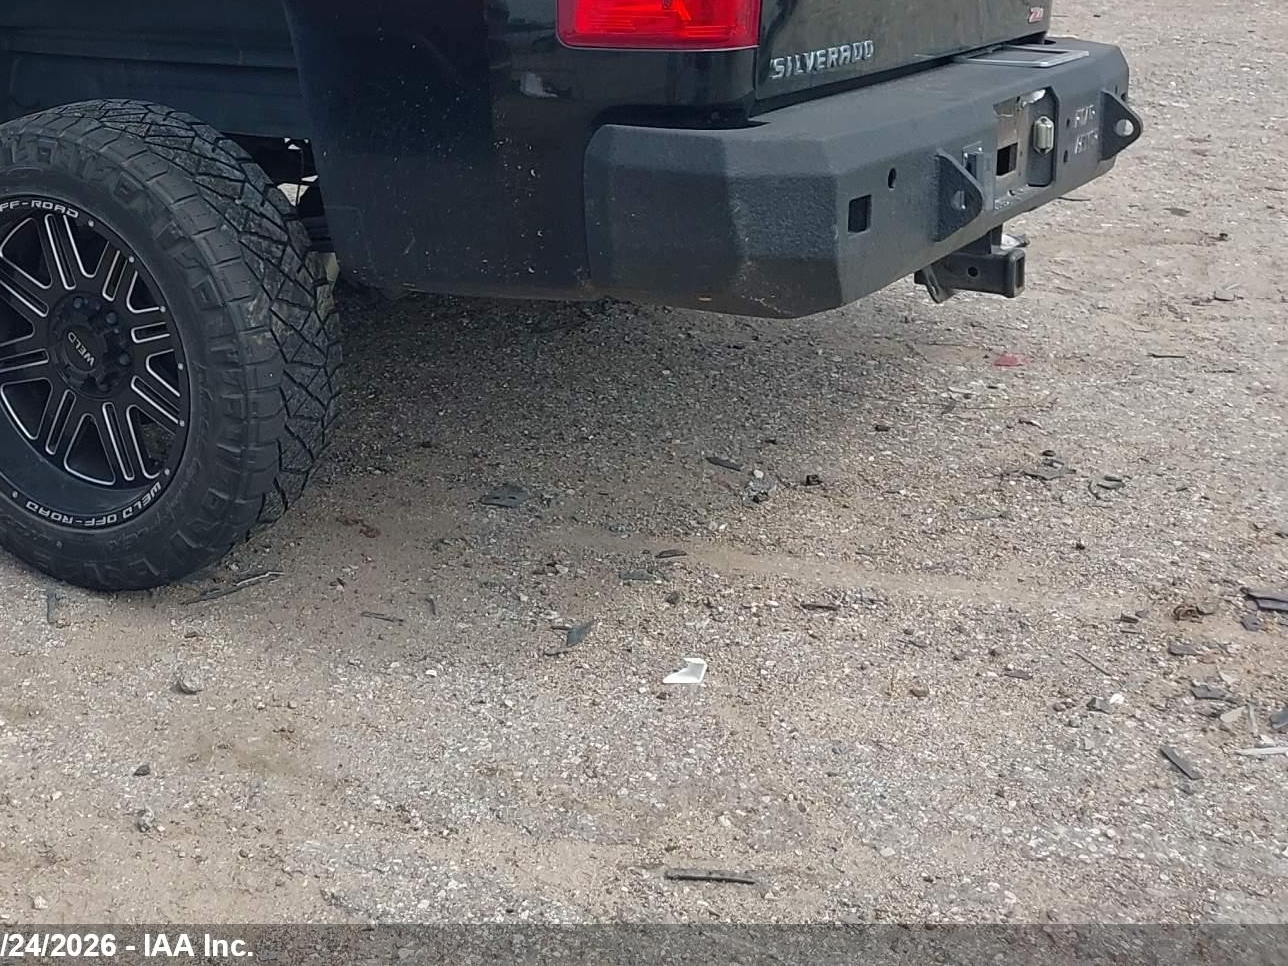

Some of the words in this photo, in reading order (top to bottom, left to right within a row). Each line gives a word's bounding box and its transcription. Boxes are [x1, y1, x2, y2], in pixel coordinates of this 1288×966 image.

[769, 40, 874, 79] SILVERADO
[68, 331, 95, 367] WELD
[25, 501, 117, 526] OFF-ROAD
[122, 481, 161, 519] WELD
